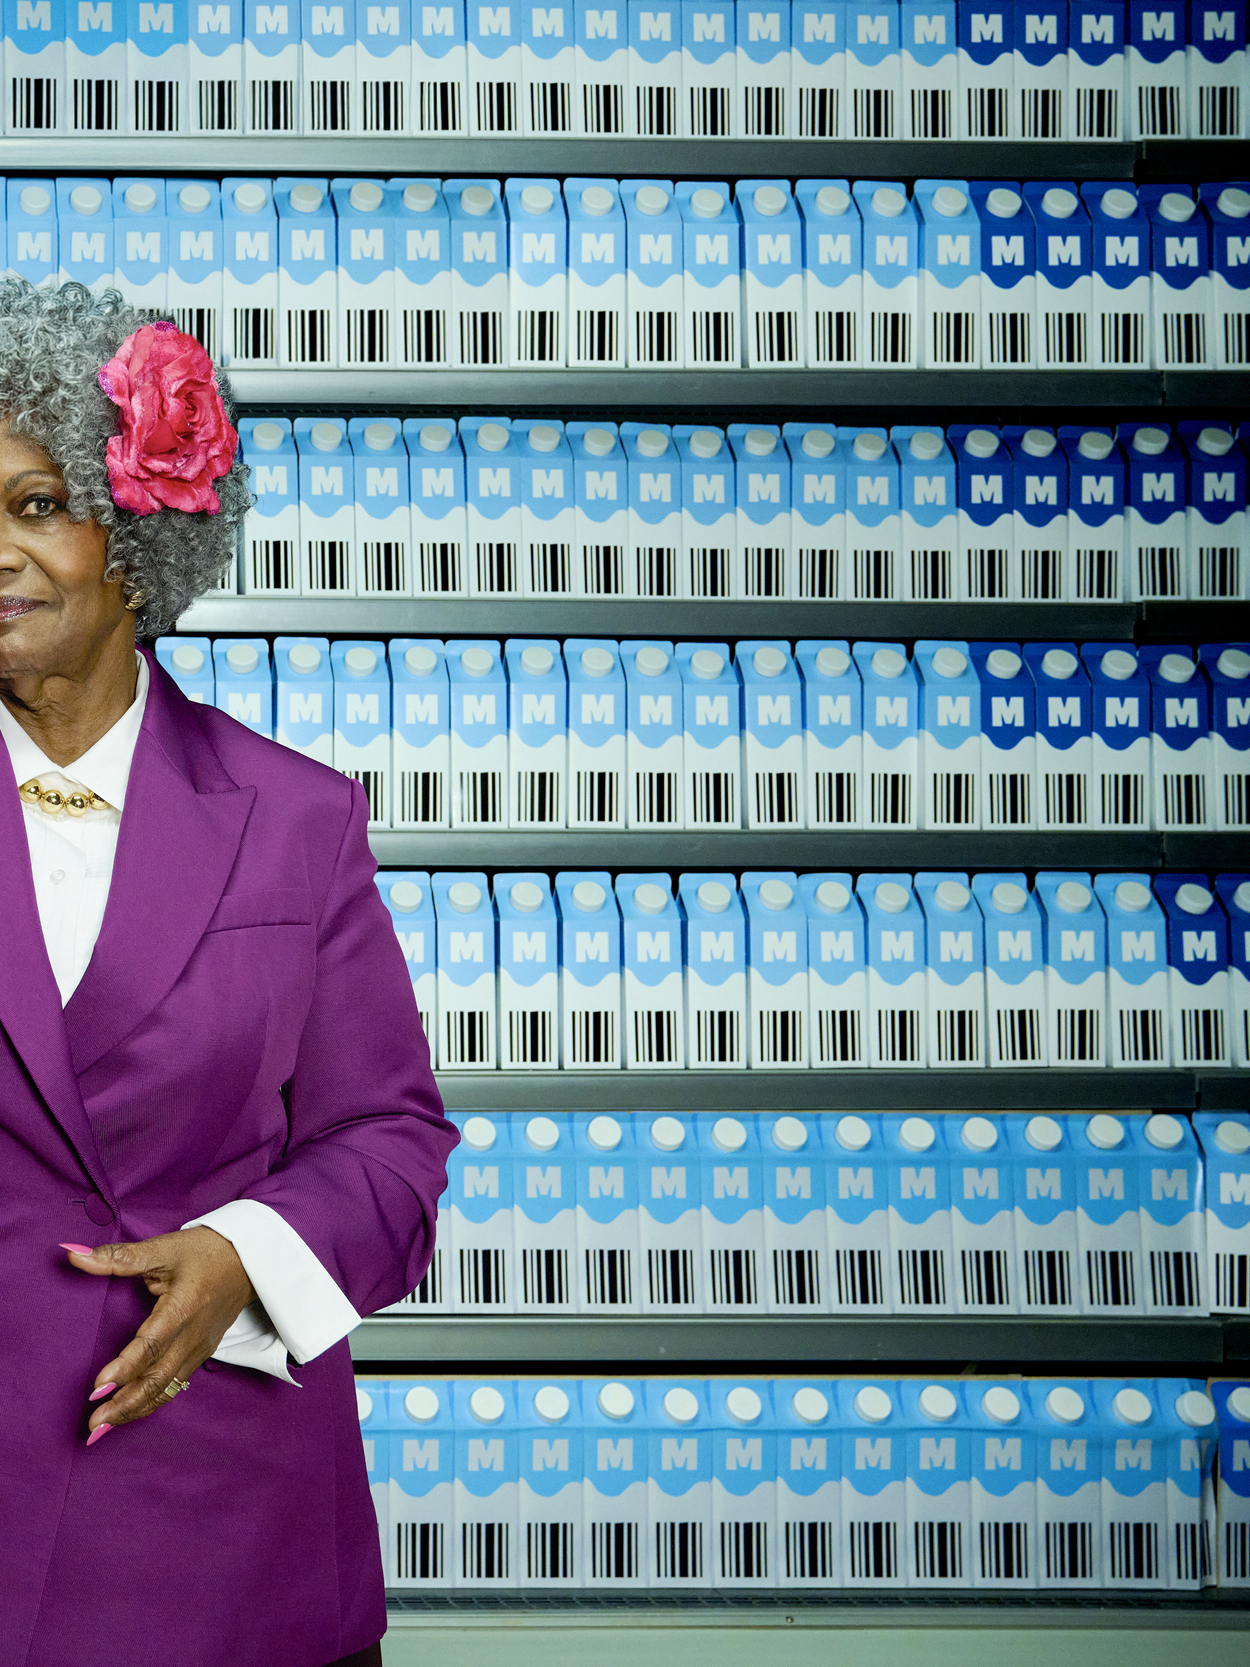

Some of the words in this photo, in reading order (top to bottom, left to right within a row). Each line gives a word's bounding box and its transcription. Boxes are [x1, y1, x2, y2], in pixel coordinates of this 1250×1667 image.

[78, 2, 112, 31] M
[198, 4, 230, 34] M
[312, 6, 344, 35] M
[423, 7, 454, 36] M
[532, 8, 564, 37] M
[640, 12, 671, 41] M
[749, 12, 780, 42] M
[858, 15, 888, 44] M
[971, 14, 1002, 43] M
[1026, 15, 1056, 44] M
[1143, 12, 1174, 40] M
[72, 232, 105, 262] M
[180, 231, 213, 260] M
[292, 229, 324, 260] M
[407, 230, 439, 260] M
[522, 233, 555, 264] M
[640, 234, 672, 264] M
[757, 234, 791, 265] M
[819, 234, 851, 264] M
[937, 234, 971, 266] M
[1048, 236, 1080, 265] M
[1165, 237, 1198, 266] M
[256, 466, 287, 494] M
[366, 468, 398, 496] M
[479, 468, 510, 497] M
[586, 471, 617, 500] M
[693, 474, 724, 503] M
[804, 474, 835, 504] M
[858, 476, 888, 505] M
[971, 475, 1002, 504] M
[1082, 476, 1113, 505] M
[1204, 473, 1234, 501] M
[290, 693, 322, 724] M
[405, 694, 438, 724] M
[522, 692, 555, 724] M
[640, 695, 672, 725] M
[757, 695, 791, 727] M
[876, 696, 907, 727] M
[992, 697, 1024, 726] M
[1106, 698, 1138, 727] M
[1165, 698, 1198, 727] M
[512, 932, 546, 963] M
[637, 931, 671, 962] M
[763, 931, 796, 962] M
[881, 930, 914, 962] M
[998, 930, 1032, 961] M
[1122, 930, 1156, 962] M
[464, 1166, 498, 1197] M
[589, 1167, 624, 1198] M
[714, 1167, 748, 1198] M
[776, 1167, 811, 1198] M
[901, 1167, 935, 1199] M
[1027, 1168, 1061, 1199] M
[1152, 1169, 1188, 1200] M
[468, 1439, 504, 1471] M
[597, 1439, 633, 1470] M
[726, 1439, 762, 1470] M
[855, 1438, 891, 1470] M
[985, 1438, 1021, 1470] M
[1115, 1439, 1151, 1470] M
